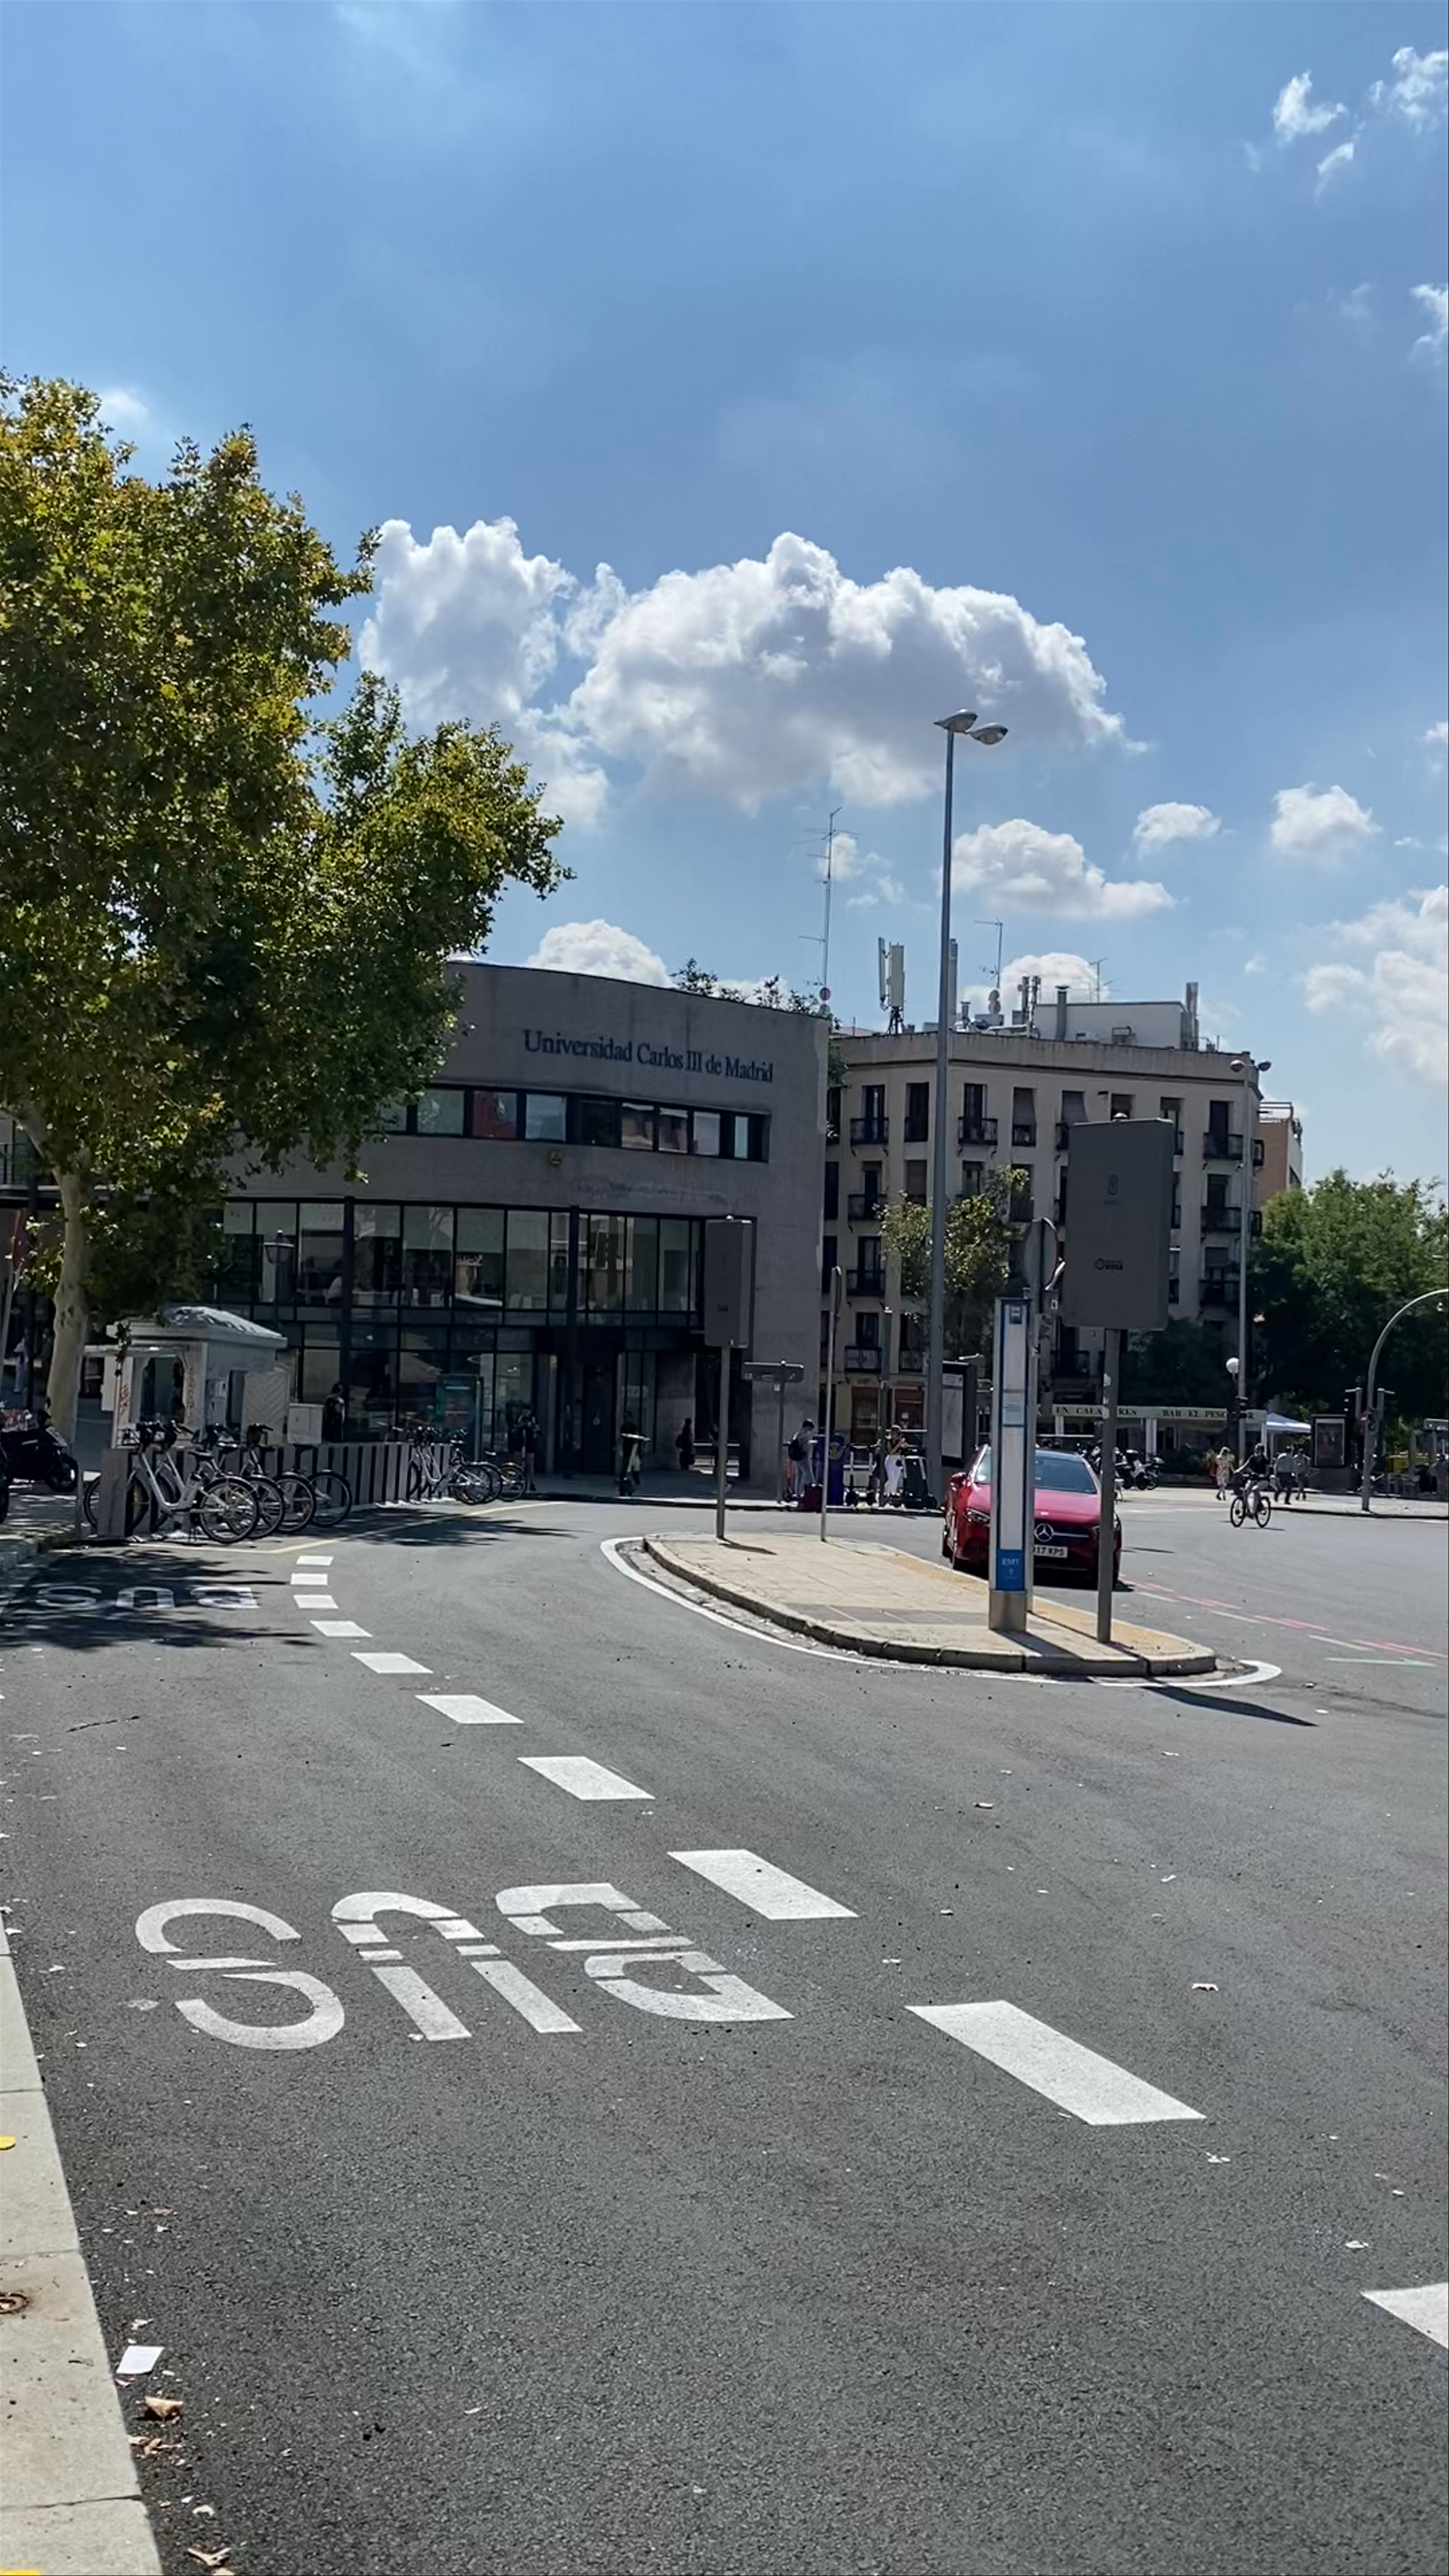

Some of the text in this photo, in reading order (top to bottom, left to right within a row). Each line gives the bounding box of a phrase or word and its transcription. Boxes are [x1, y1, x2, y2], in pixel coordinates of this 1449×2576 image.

[524, 1029, 772, 1083] Universidad Carlos III de Madrid
[36, 1586, 260, 1610] BUS
[135, 1882, 795, 2050] BUS
